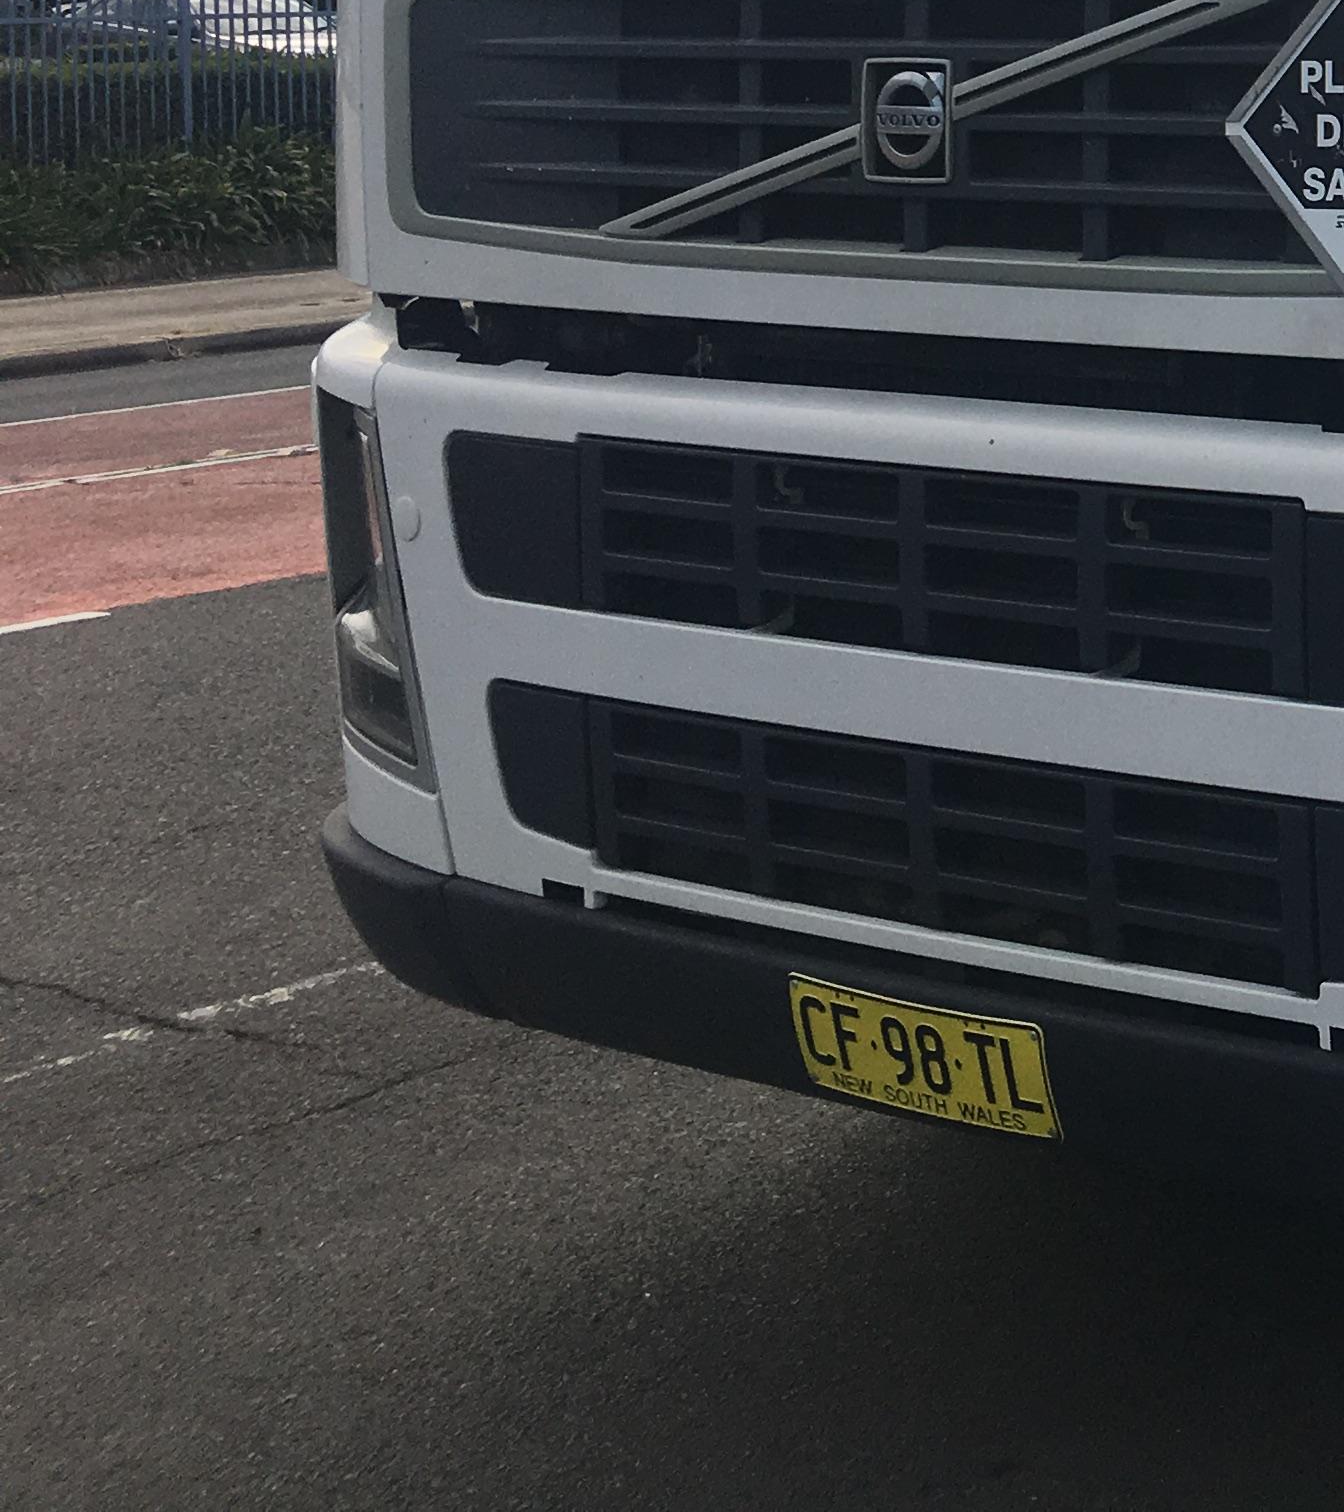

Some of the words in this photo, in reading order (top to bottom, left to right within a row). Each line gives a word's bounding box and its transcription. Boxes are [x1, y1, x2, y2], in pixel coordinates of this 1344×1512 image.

[877, 113, 940, 127] VOLVO
[832, 1071, 873, 1095] NEW
[883, 1085, 949, 1116] SOUTH
[957, 1103, 1027, 1130] WALES
